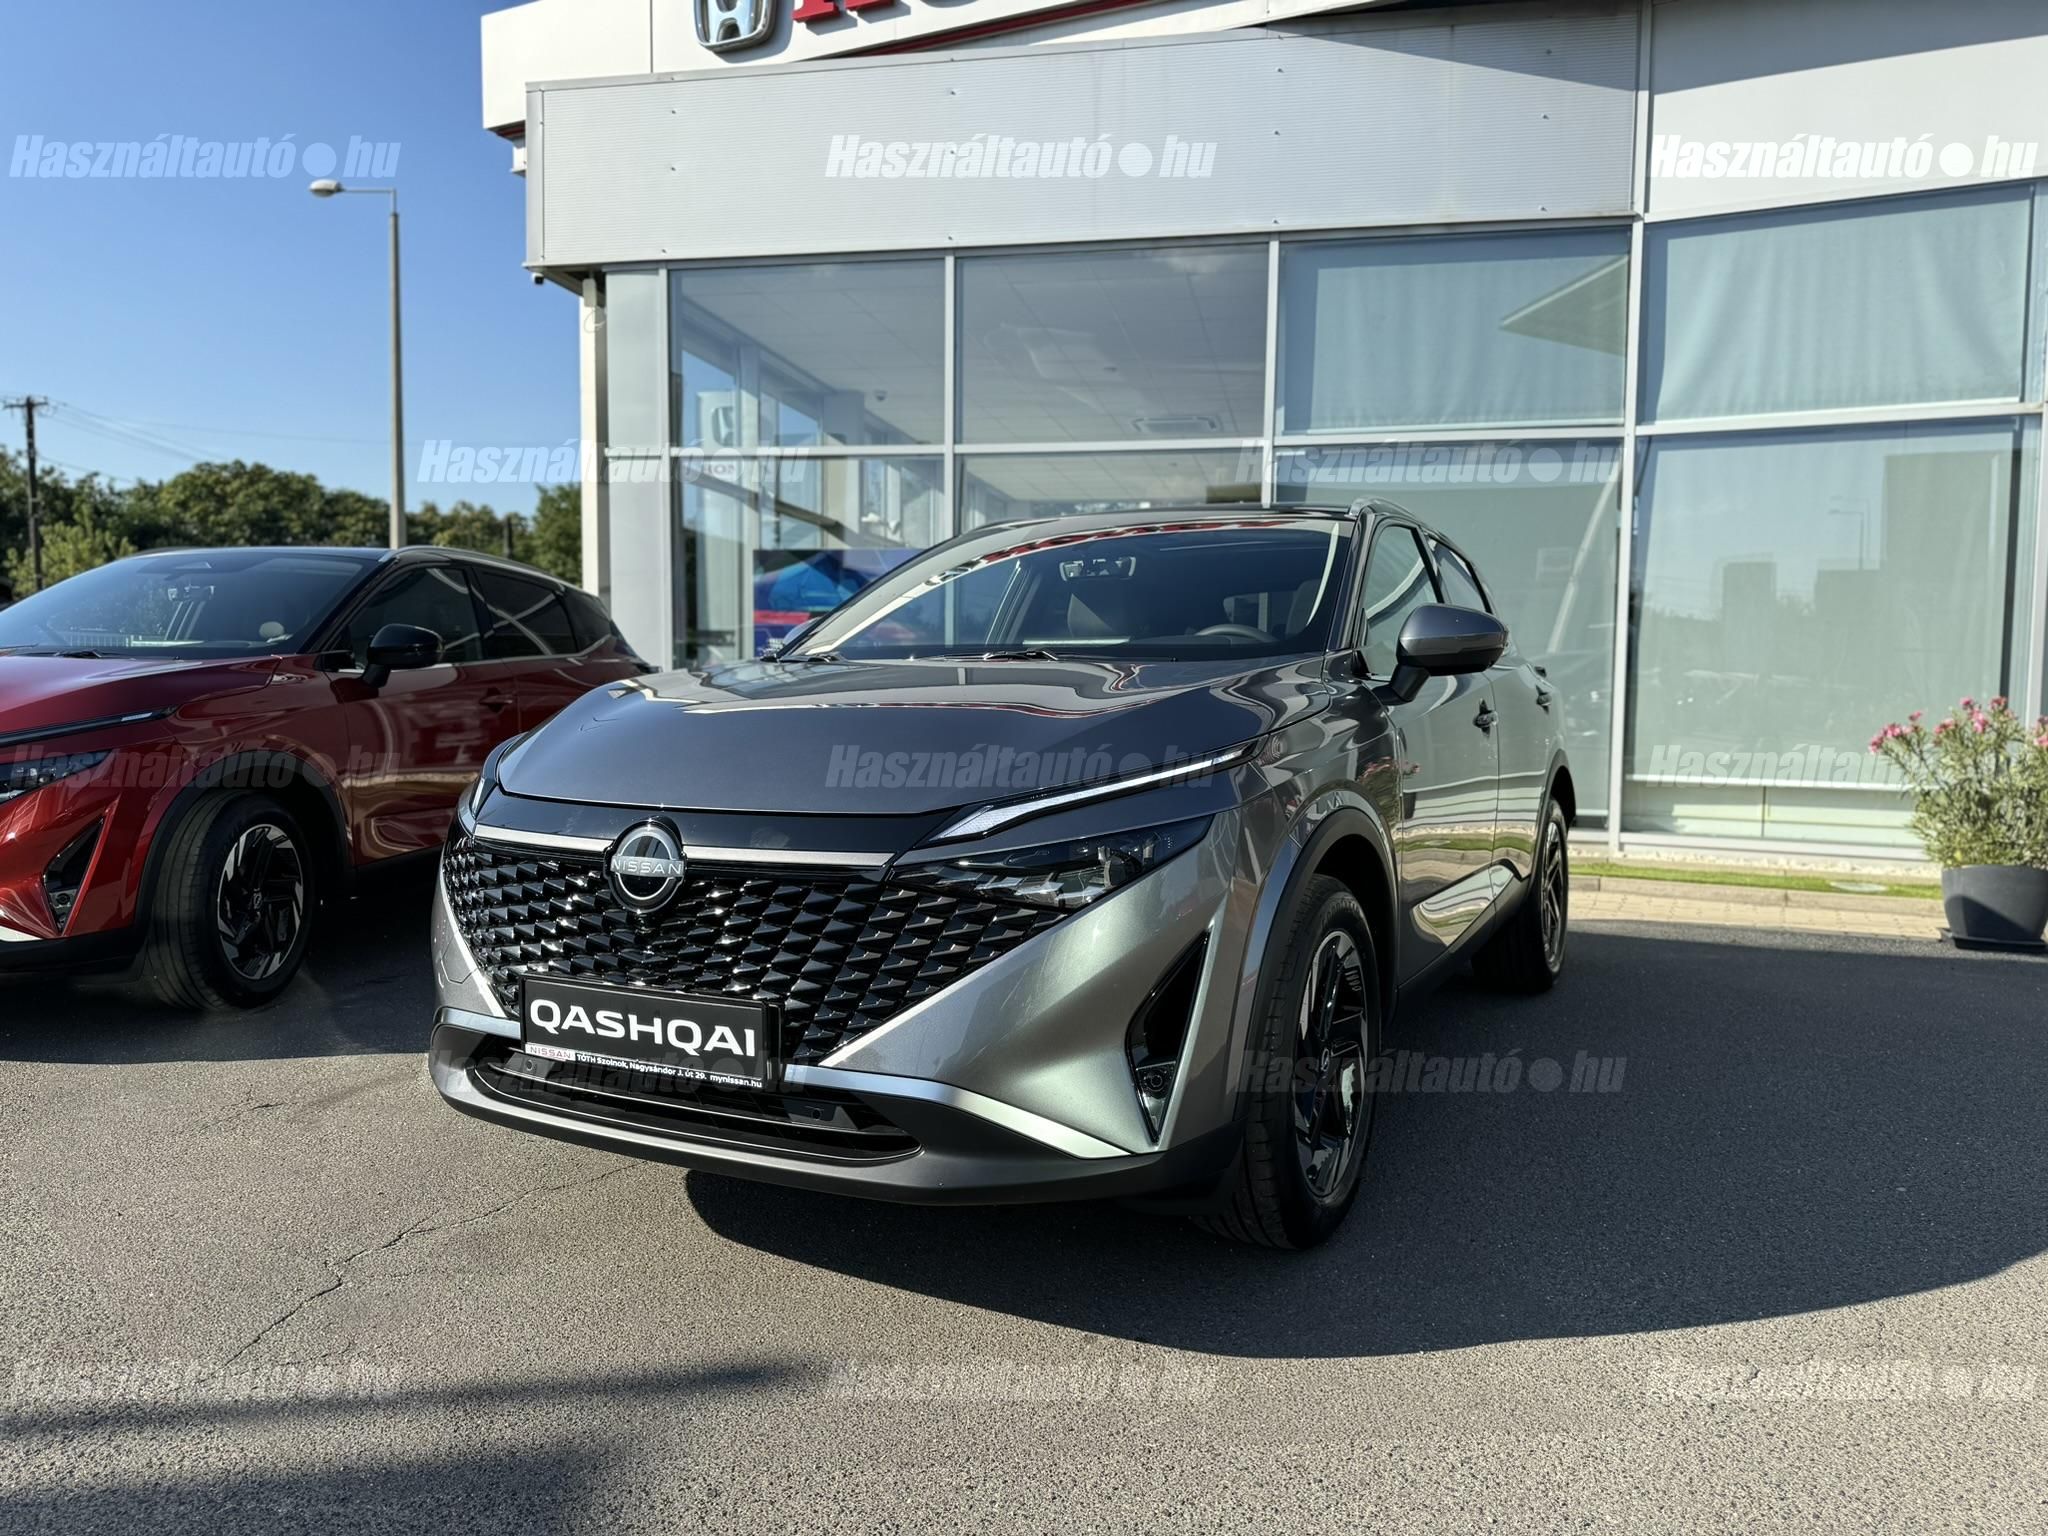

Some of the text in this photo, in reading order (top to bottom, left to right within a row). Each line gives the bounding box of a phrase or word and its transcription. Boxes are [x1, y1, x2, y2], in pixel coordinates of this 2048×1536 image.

[612, 858, 681, 875] NISSAN
[530, 999, 755, 1057] QASHQAI
[530, 1046, 571, 1059] NISSAN
[597, 1057, 629, 1069] Szolnok,
[629, 1062, 676, 1076] Nagysándor
[710, 1074, 762, 1088] mynissan.hu
